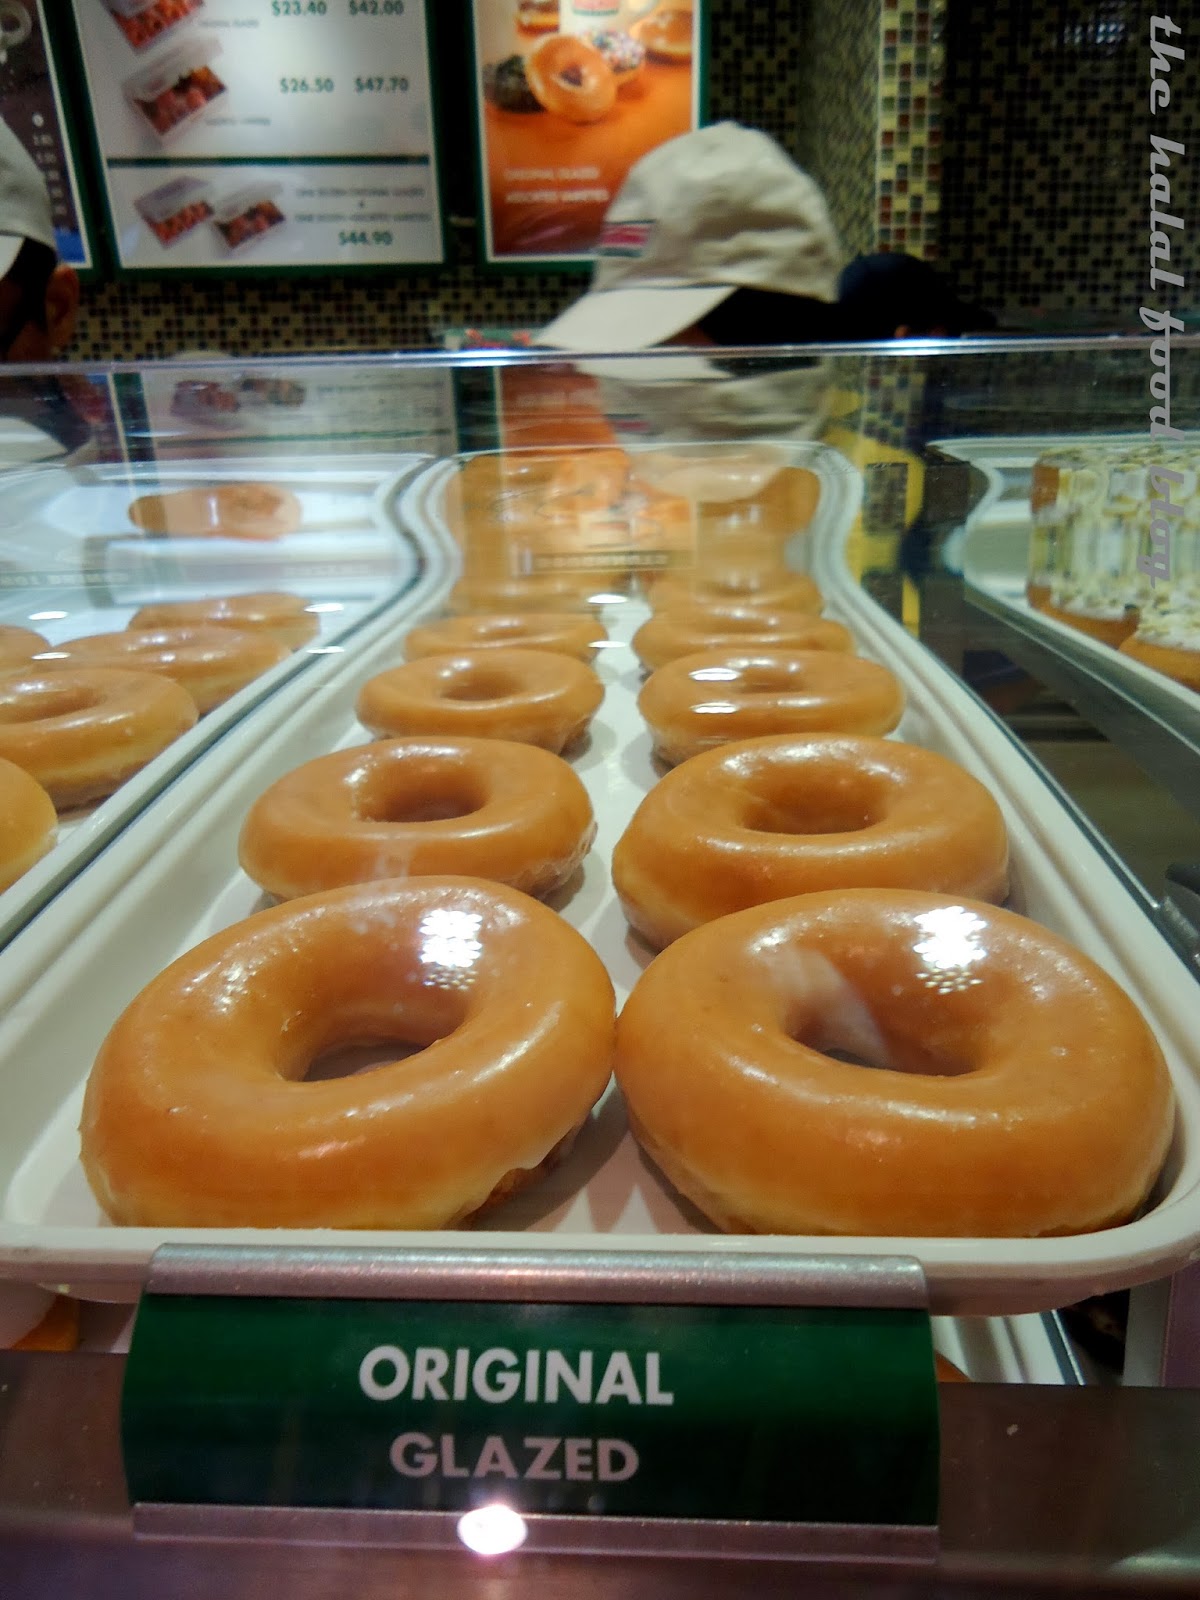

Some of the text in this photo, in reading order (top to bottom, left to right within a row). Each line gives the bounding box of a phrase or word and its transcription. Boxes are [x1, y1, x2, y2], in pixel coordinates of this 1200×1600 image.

[271, 0, 327, 16] $23.40
[280, 77, 409, 94] $26.50 $47.70
[359, 1345, 674, 1405] ORIGINAL
[389, 1432, 640, 1482] GLAZED
